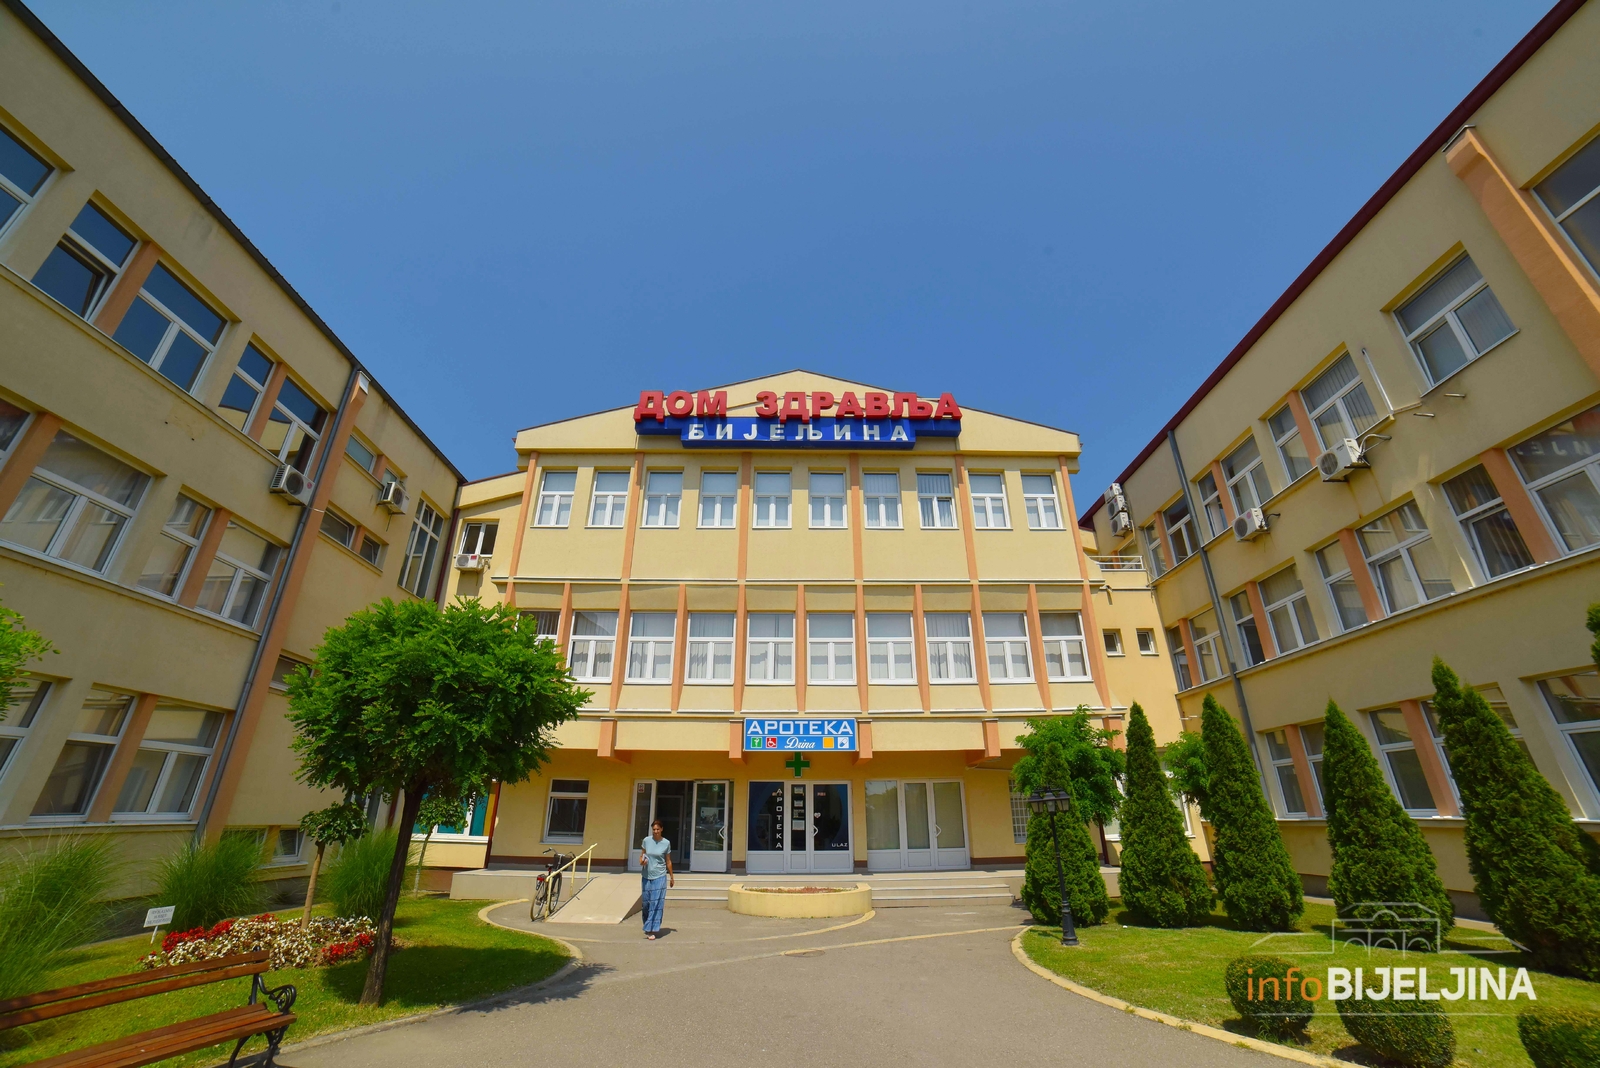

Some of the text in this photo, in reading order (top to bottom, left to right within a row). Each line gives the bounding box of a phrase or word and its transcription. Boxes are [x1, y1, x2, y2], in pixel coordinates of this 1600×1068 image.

[634, 390, 963, 423] ДОМ ЗДРАВЉА
[688, 423, 909, 441] БИЈЕЉИНА
[747, 720, 854, 735] APOTEKA
[784, 736, 816, 749] Drina
[775, 788, 783, 849] APOTEKA
